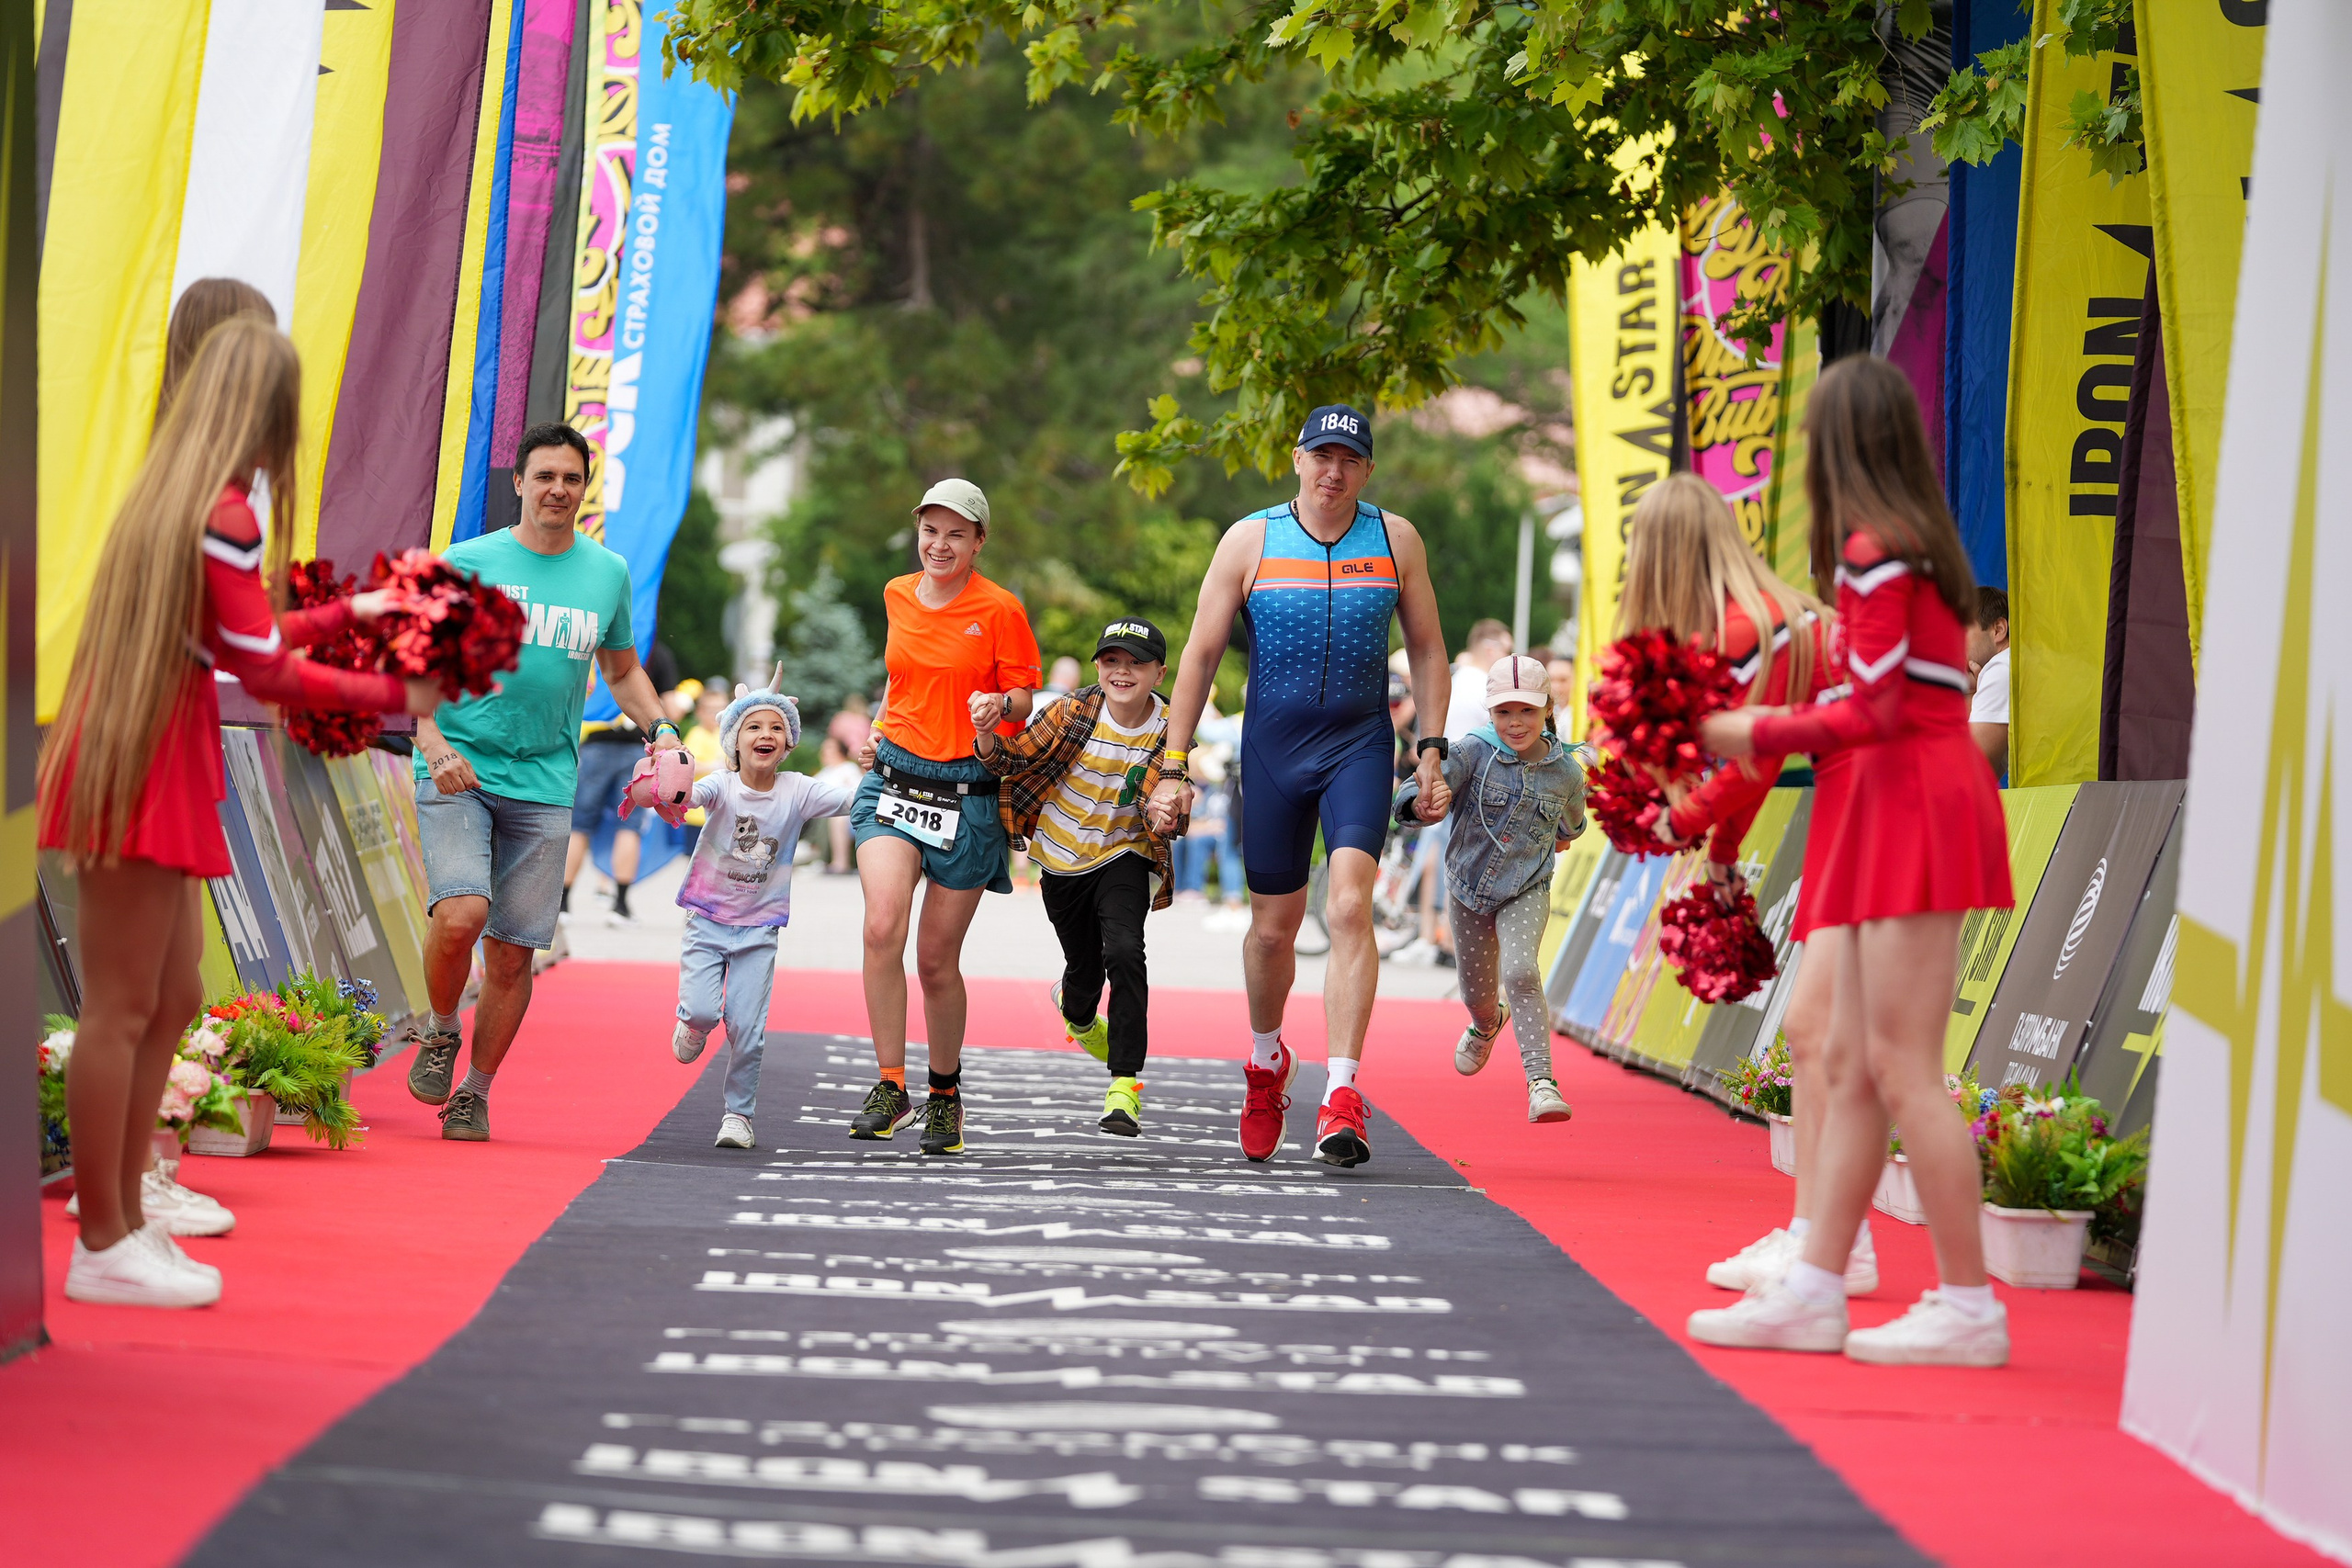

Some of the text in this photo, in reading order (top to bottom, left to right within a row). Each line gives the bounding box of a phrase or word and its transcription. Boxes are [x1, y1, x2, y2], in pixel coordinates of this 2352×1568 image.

[622, 192, 662, 350] СТРАХОВОЙ
[643, 122, 673, 189] ДОМ
[1613, 257, 1657, 399] STAR
[1320, 412, 1359, 434] 1845
[2069, 296, 2144, 516] IRON
[1129, 623, 1150, 637] STAR
[432, 752, 458, 771] 2018
[891, 802, 944, 832] 2018
[2007, 1011, 2070, 1060] ГАЗПРОМБАНК
